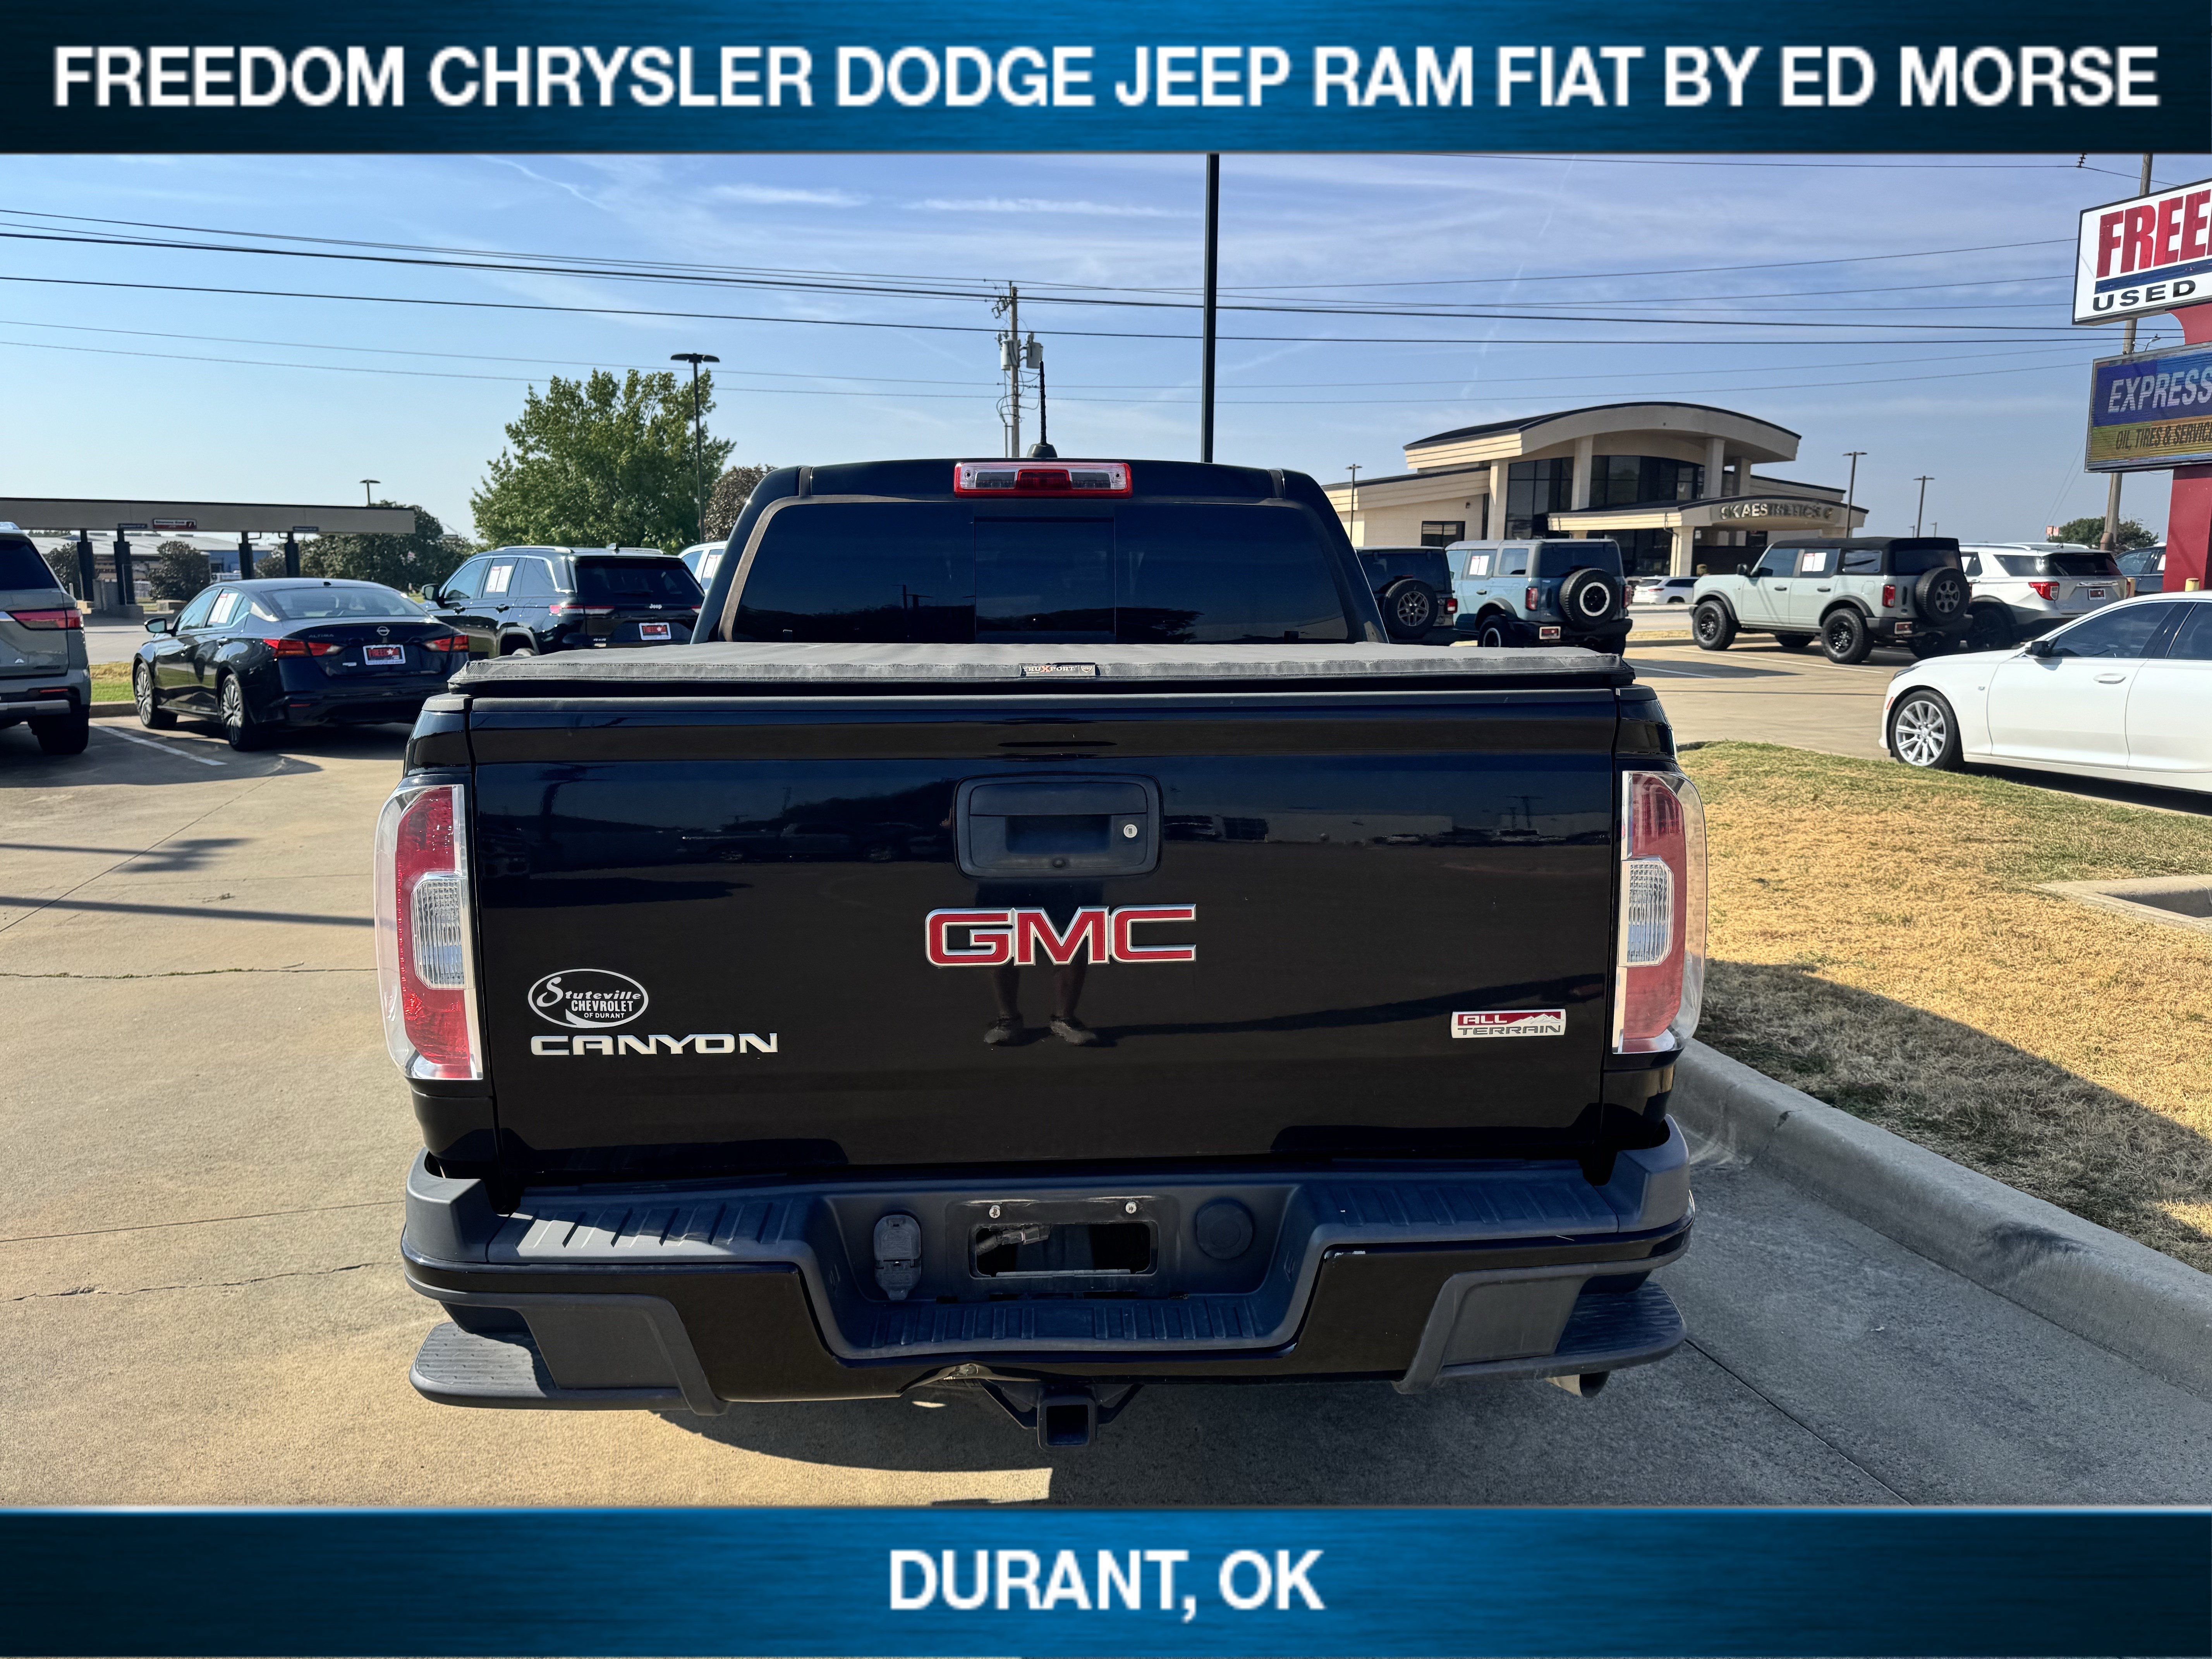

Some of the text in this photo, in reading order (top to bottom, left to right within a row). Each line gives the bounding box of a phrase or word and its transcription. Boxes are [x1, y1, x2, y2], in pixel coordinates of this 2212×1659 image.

[2096, 189, 2212, 278] FREE
[2093, 280, 2196, 311] USED
[2108, 366, 2212, 413] EXPRESS
[925, 903, 1196, 967] GMC
[537, 977, 641, 1007] Stuteville
[571, 1000, 634, 1012] CHEVROLET
[1457, 1025, 1561, 1036] TERRAIN
[1463, 1015, 1508, 1024] ALL
[531, 1033, 778, 1056] CANYON
